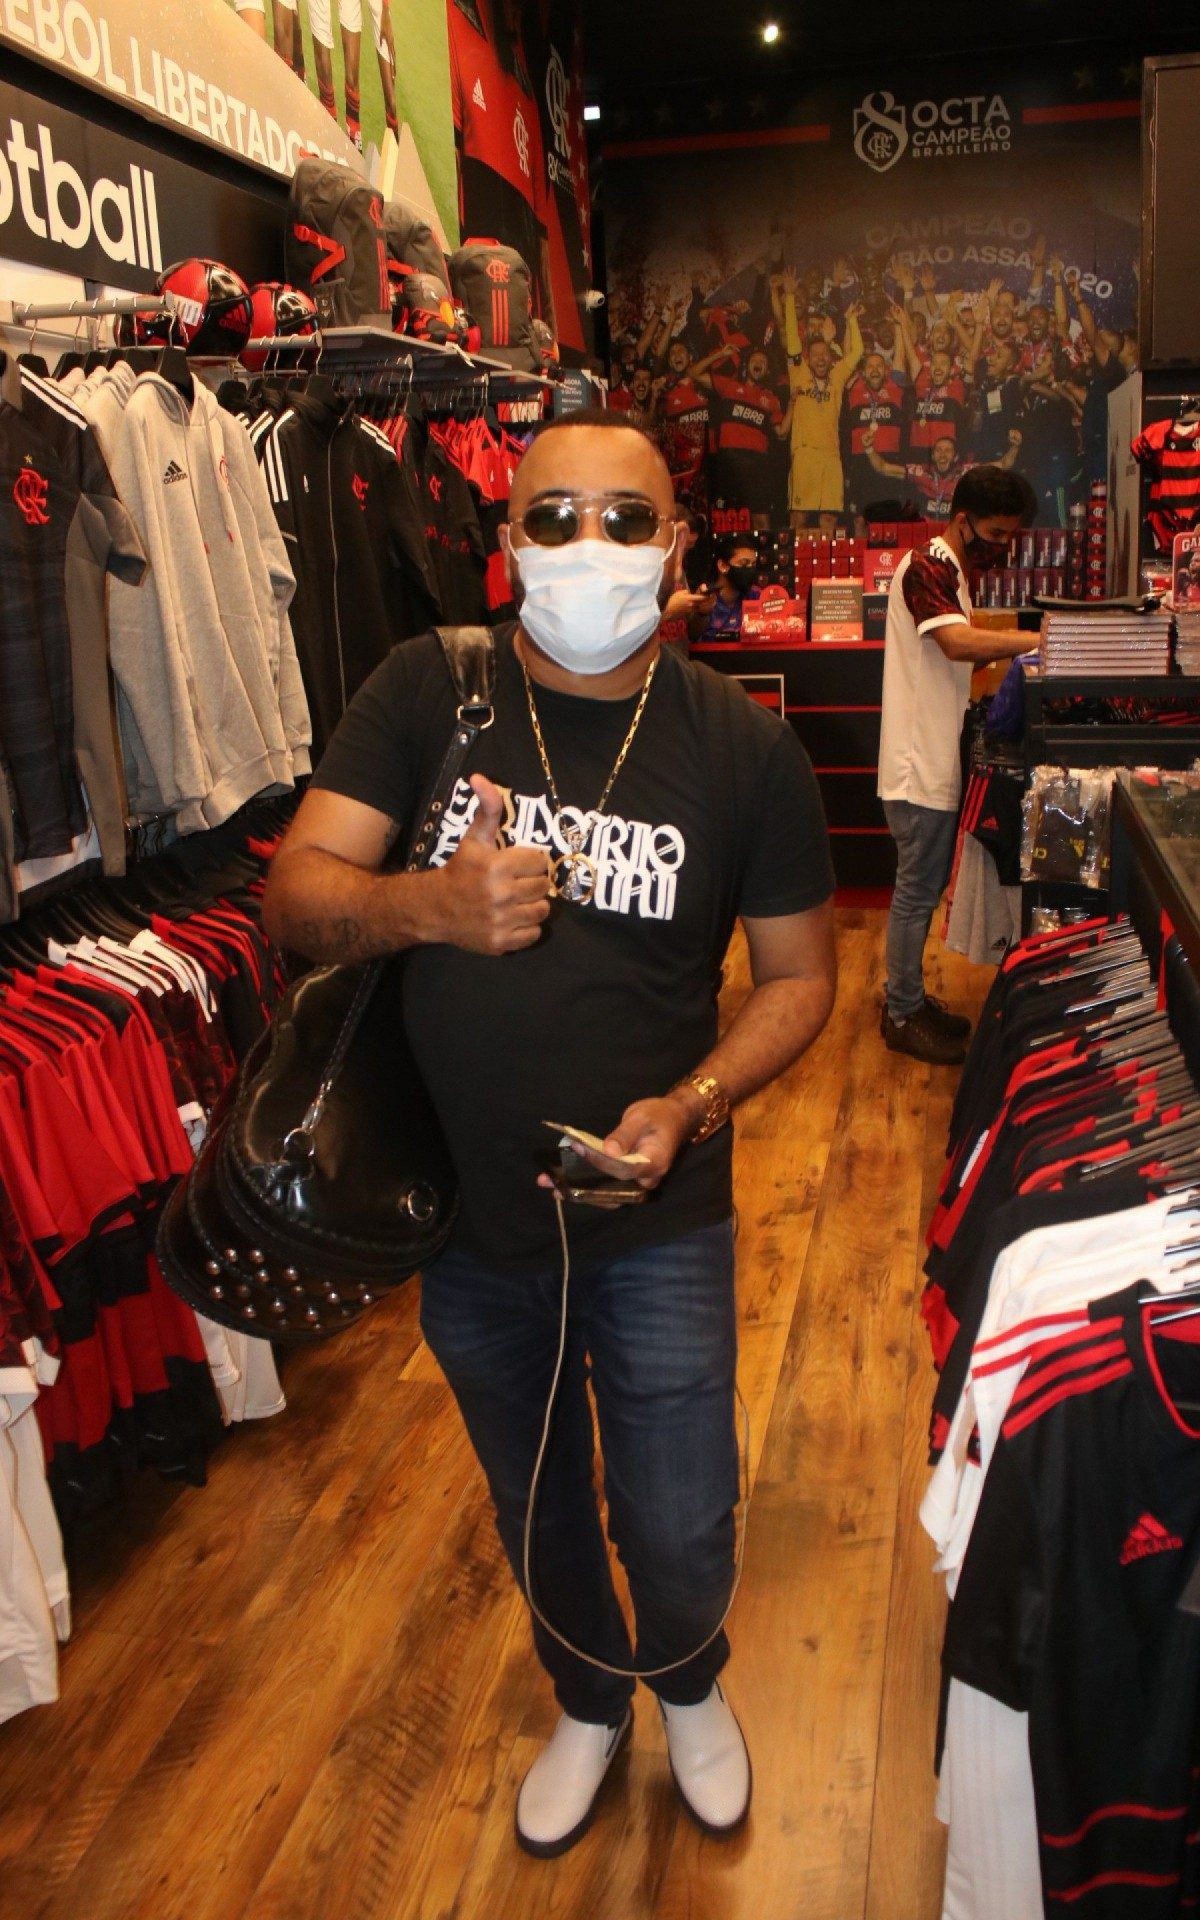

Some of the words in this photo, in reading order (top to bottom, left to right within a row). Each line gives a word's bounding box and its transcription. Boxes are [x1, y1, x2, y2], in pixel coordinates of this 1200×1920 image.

[0, 0, 127, 93] EBOL
[130, 36, 350, 177] LIBERTADO
[912, 94, 1011, 128] OCTA
[912, 122, 1011, 147] CAMPEÃO
[912, 141, 1011, 158] BRASILEIRO
[961, 245, 1034, 270] ASSA
